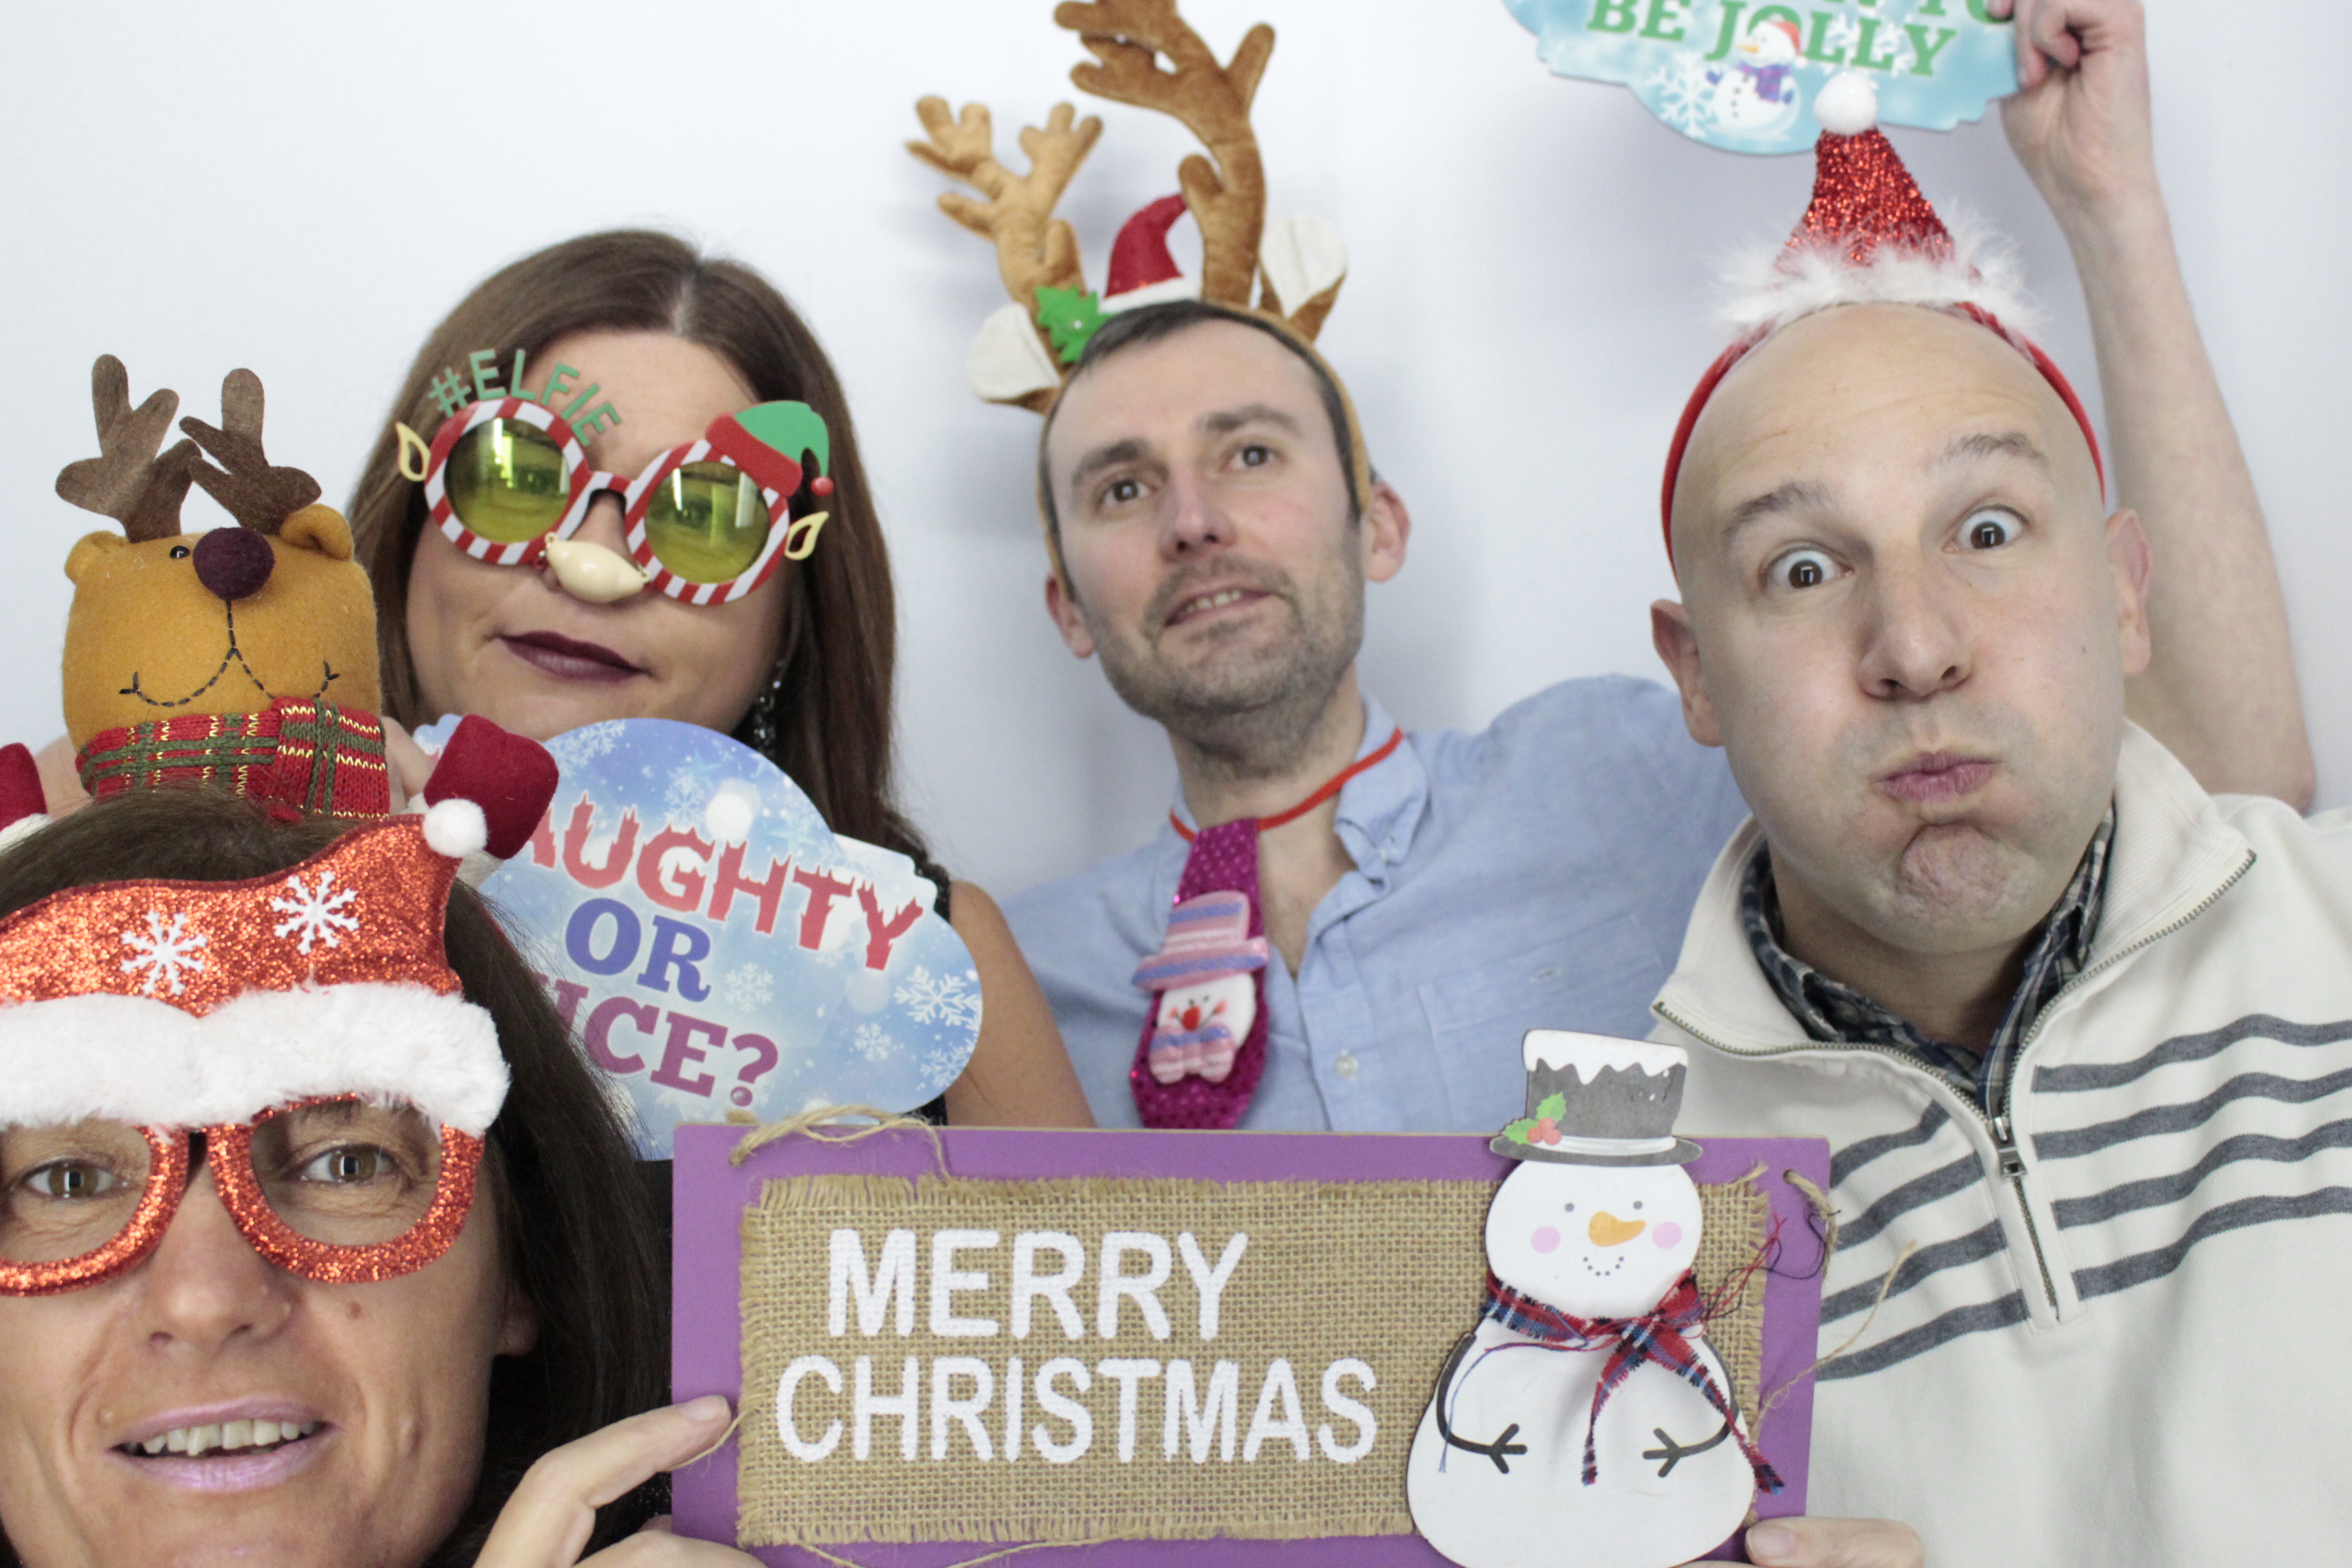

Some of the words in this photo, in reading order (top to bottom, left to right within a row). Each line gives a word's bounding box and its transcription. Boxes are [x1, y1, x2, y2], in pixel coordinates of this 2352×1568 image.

[1586, 0, 1684, 42] BE
[428, 349, 621, 447] #ELFIE
[430, 747, 924, 971] UGHTY
[565, 897, 711, 1002] OR
[532, 971, 779, 1107] ICE?
[828, 1228, 1249, 1341] MERRY
[775, 1354, 1378, 1465] CHRISTMAS
